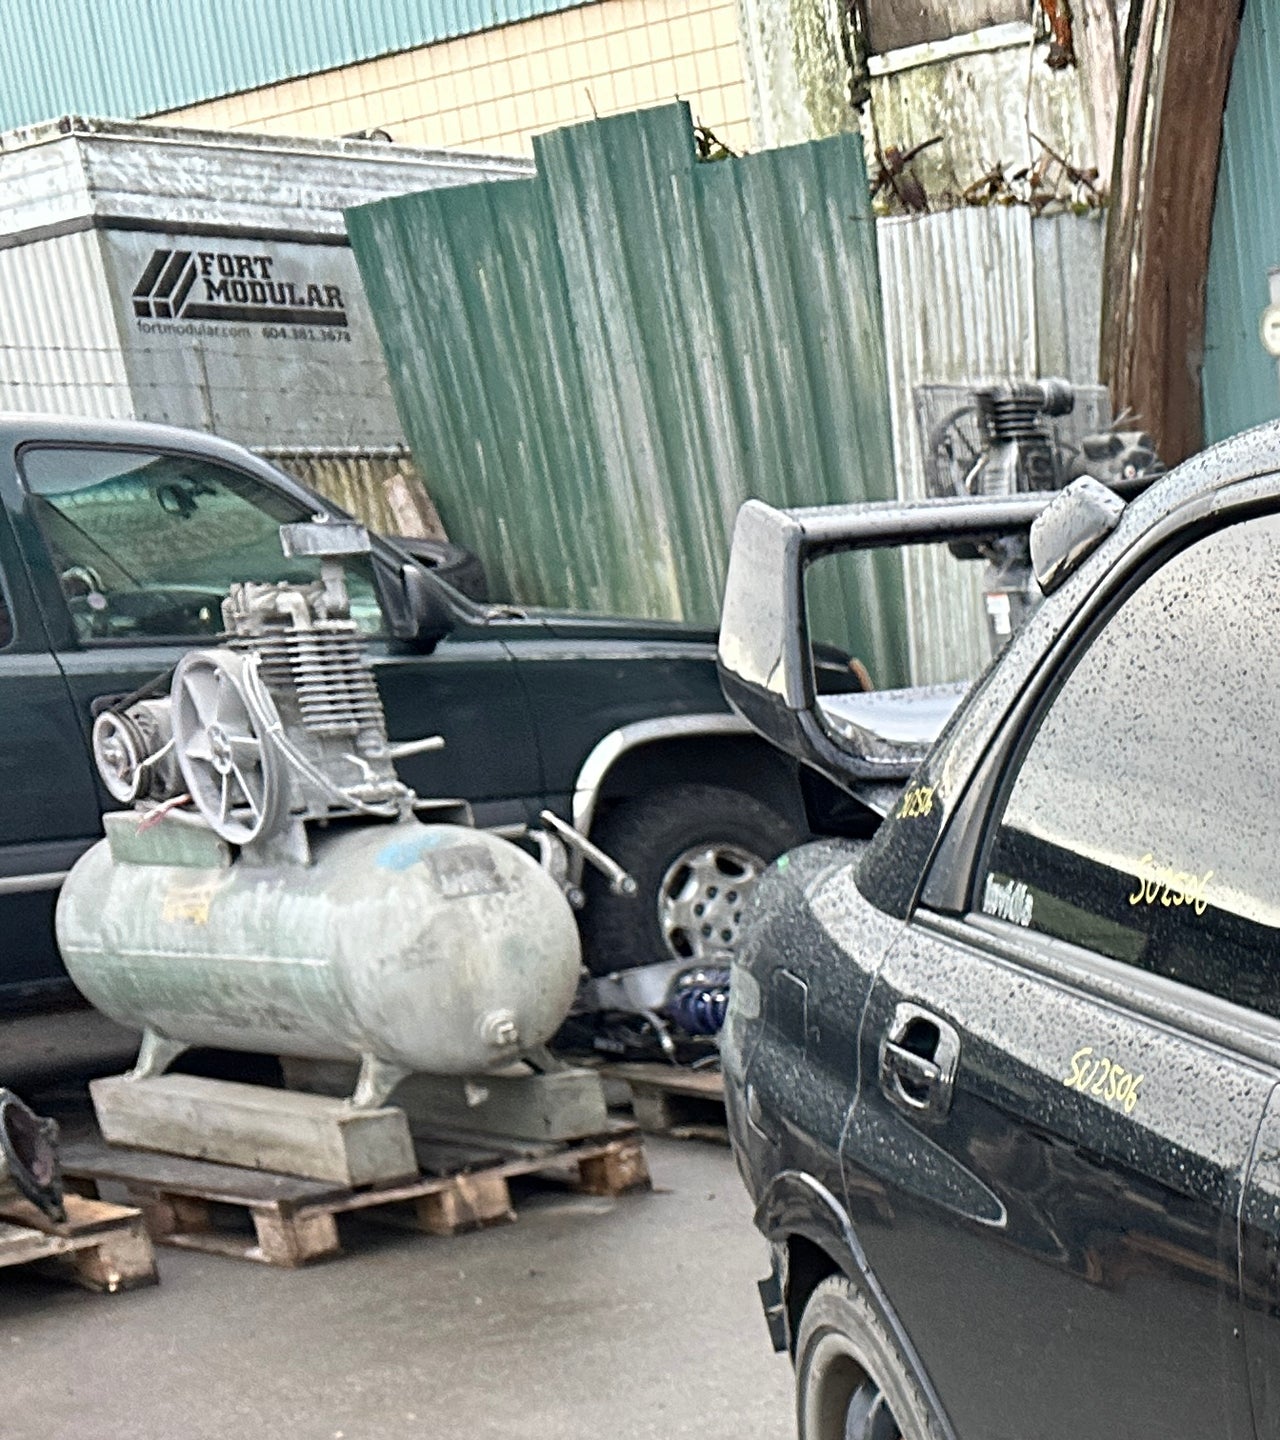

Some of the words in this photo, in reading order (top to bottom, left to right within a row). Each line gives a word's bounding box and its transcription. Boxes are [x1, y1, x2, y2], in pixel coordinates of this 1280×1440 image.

[198, 252, 274, 280] FORT
[203, 277, 346, 308] MODULAR
[1128, 852, 1214, 916] SU2506
[1063, 1046, 1145, 1113] SU2506
